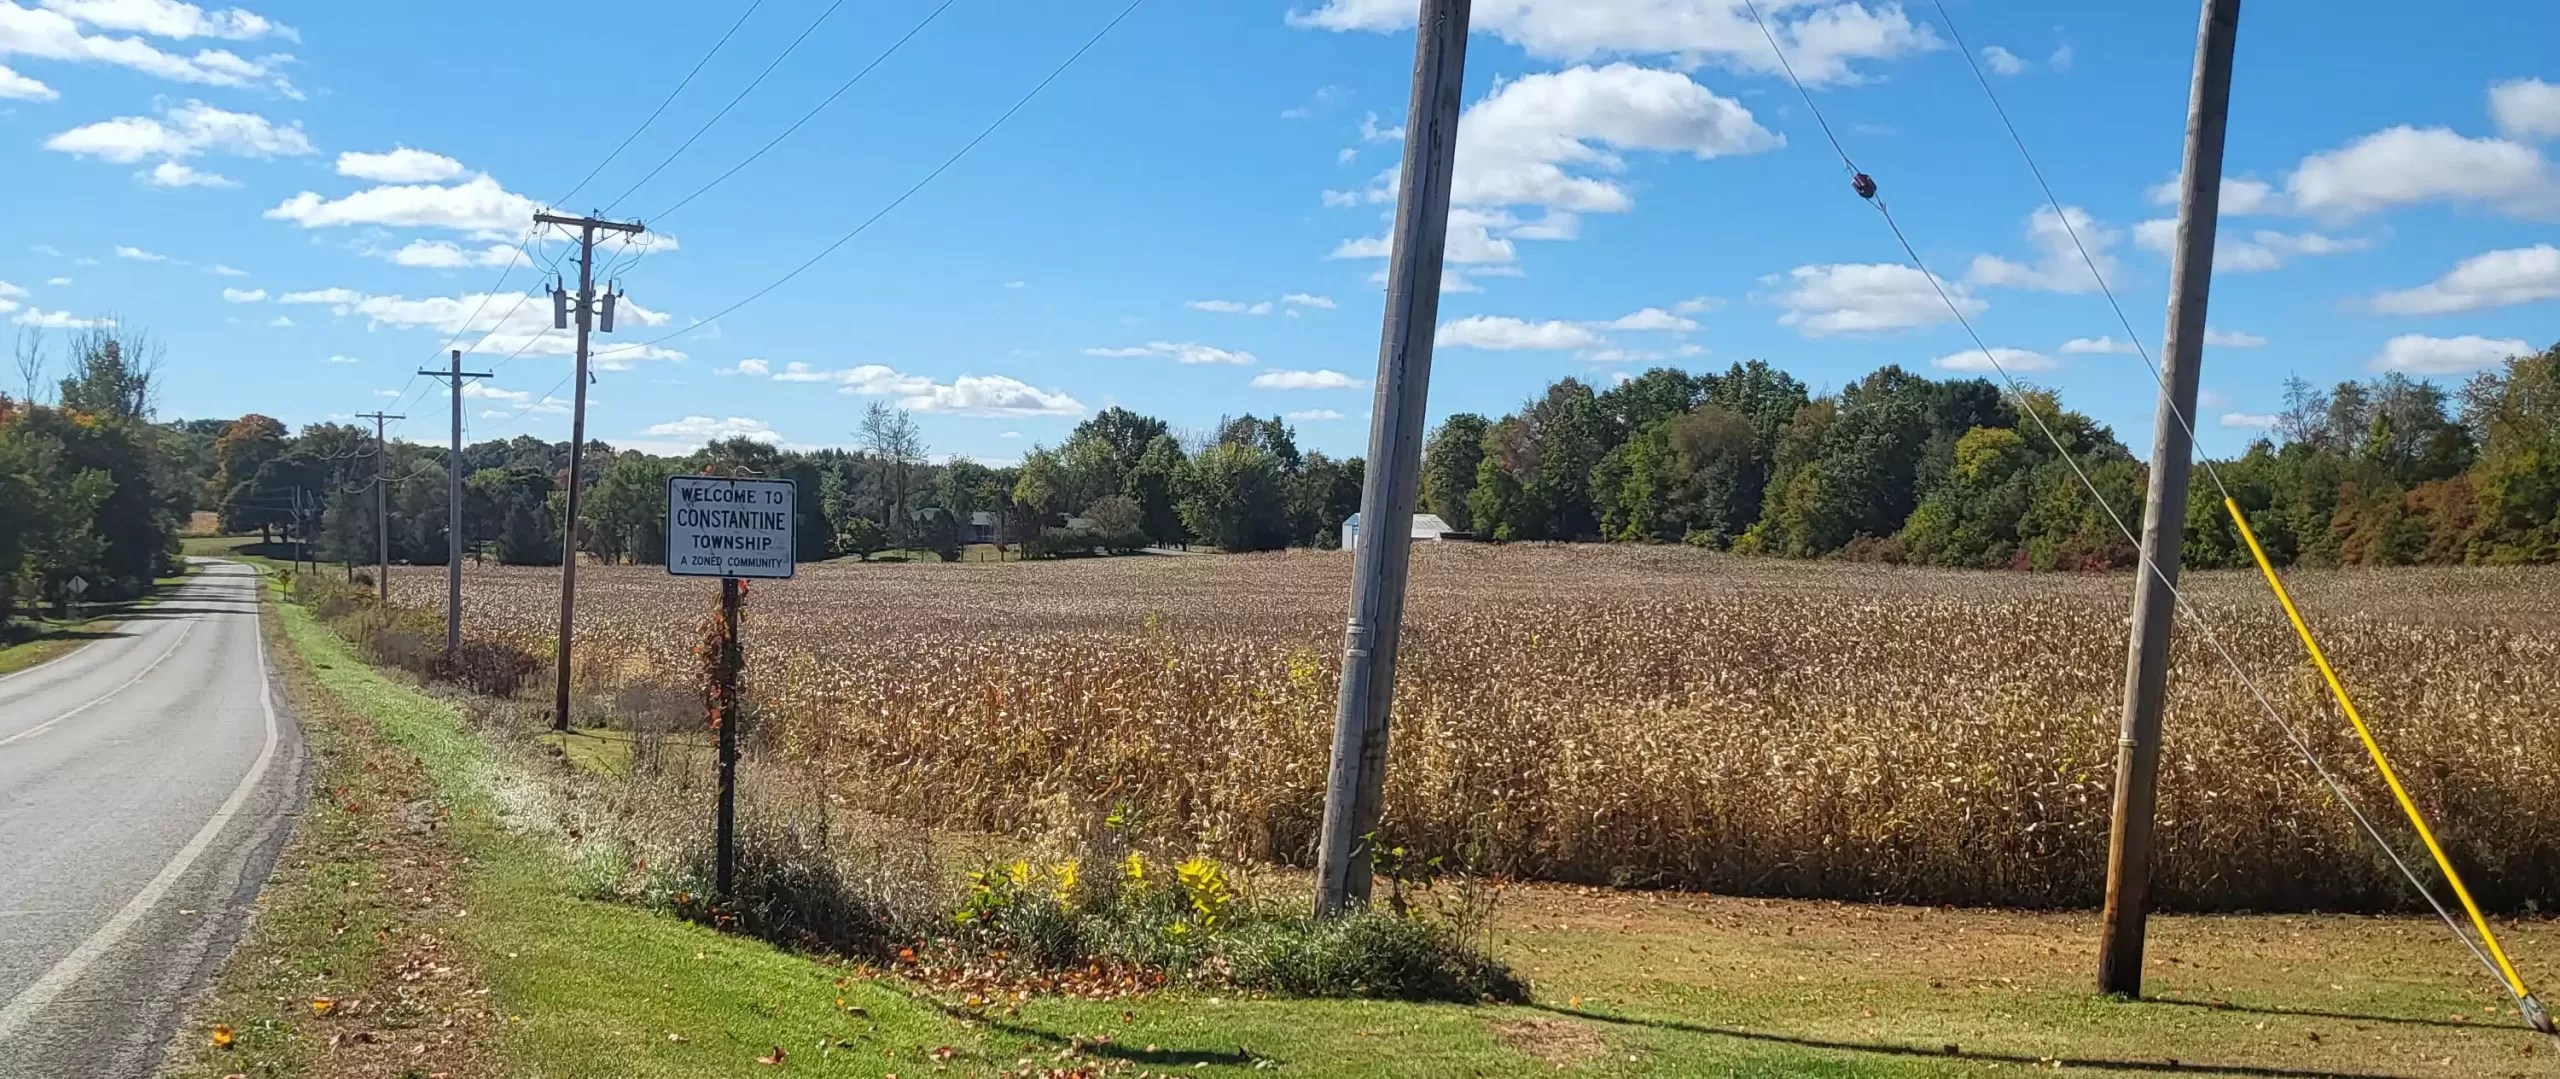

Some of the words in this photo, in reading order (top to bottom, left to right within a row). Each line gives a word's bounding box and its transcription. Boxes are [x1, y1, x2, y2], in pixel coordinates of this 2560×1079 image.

[682, 487, 756, 504] WELCOME
[765, 491, 783, 504] TO
[677, 508, 785, 530] CONSTANTINE
[692, 534, 772, 550] TOWNSHIP
[680, 556, 687, 565] A
[692, 556, 722, 566] ZONED
[727, 557, 782, 568] COMMUNITY
